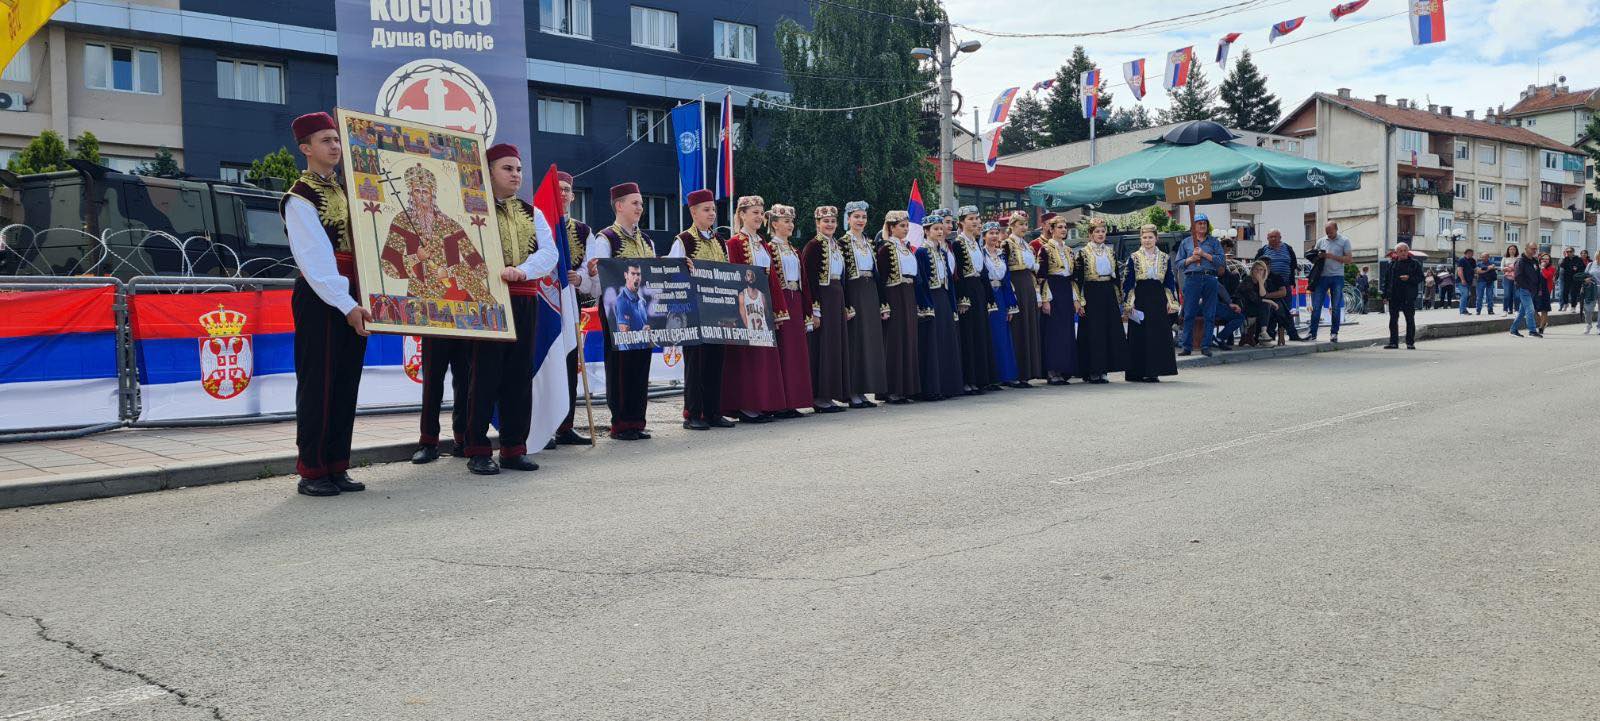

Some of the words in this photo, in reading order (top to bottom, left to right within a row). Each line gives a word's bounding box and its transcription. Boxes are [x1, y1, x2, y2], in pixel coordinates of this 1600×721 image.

[370, 0, 492, 26] КОСОВО
[371, 27, 426, 48] Душа
[429, 29, 494, 51] Србије
[1116, 177, 1155, 195] Carlsberg
[1175, 175, 1188, 185] UN
[1178, 183, 1205, 200] HELP
